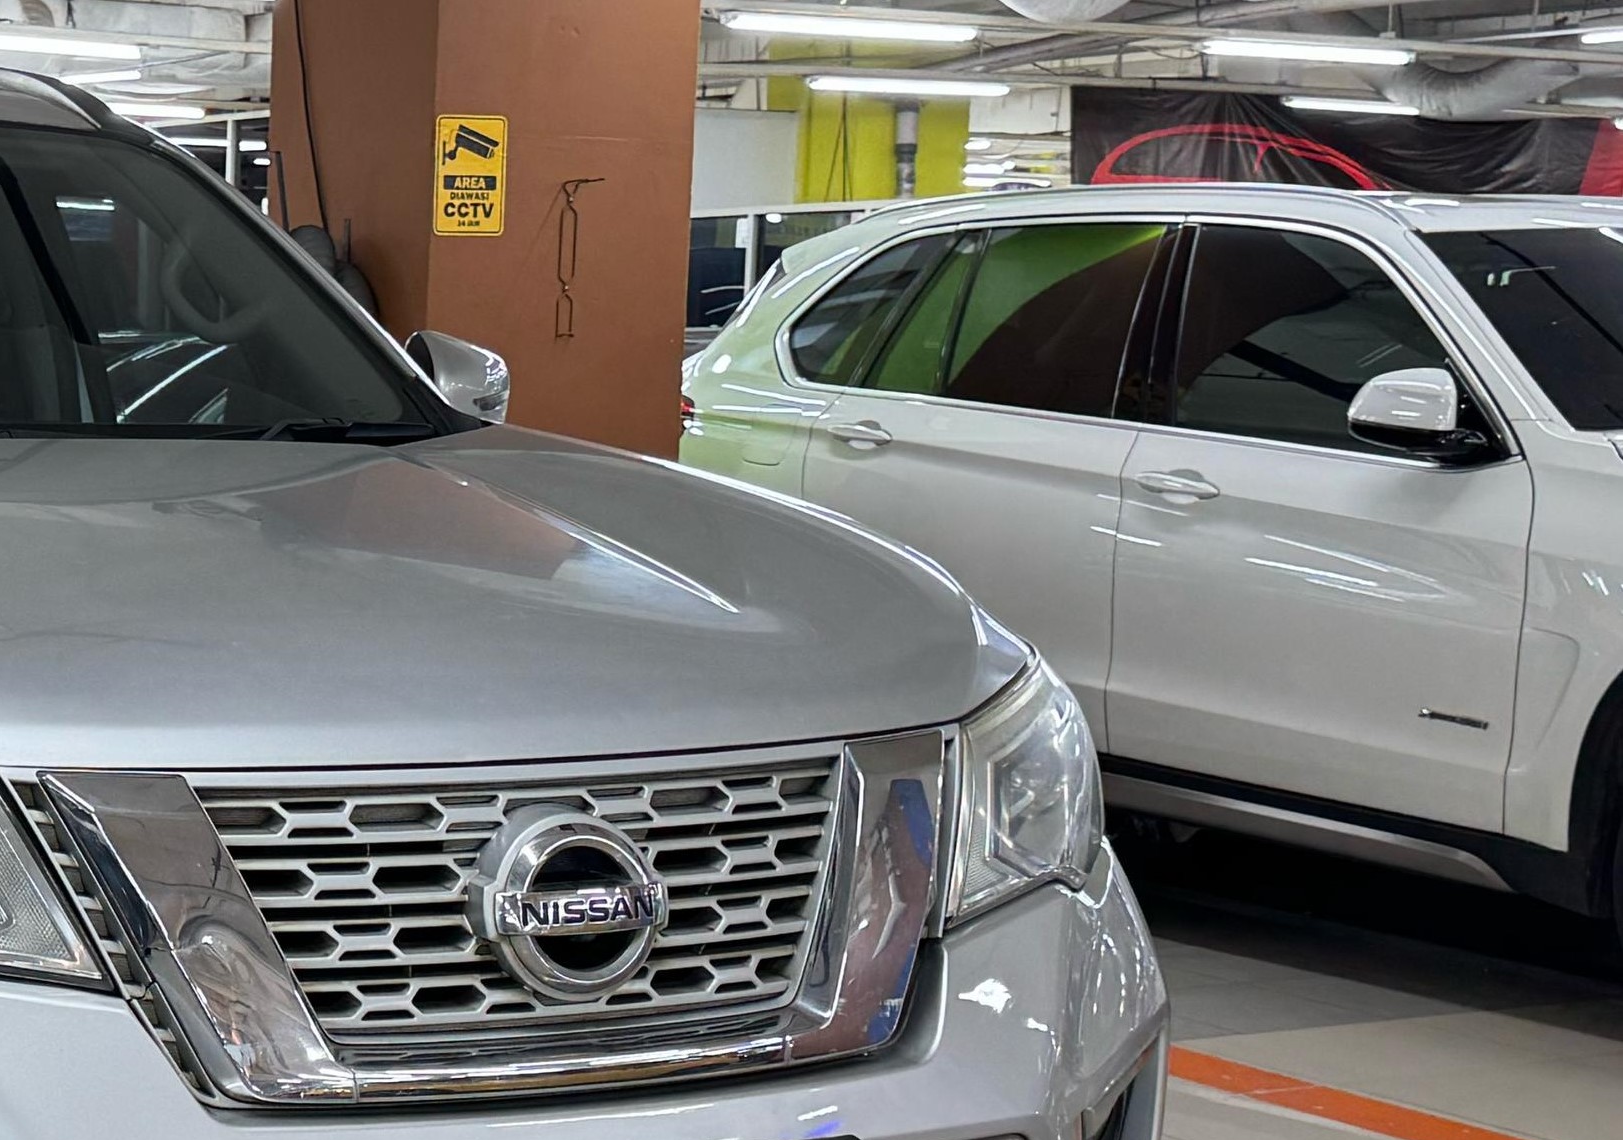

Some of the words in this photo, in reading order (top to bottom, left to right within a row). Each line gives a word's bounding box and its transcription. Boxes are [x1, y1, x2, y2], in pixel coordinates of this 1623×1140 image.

[454, 176, 486, 189] AREA
[450, 192, 490, 200] DIAWASI
[444, 202, 494, 218] CCTV
[522, 891, 654, 927] NISSAN
